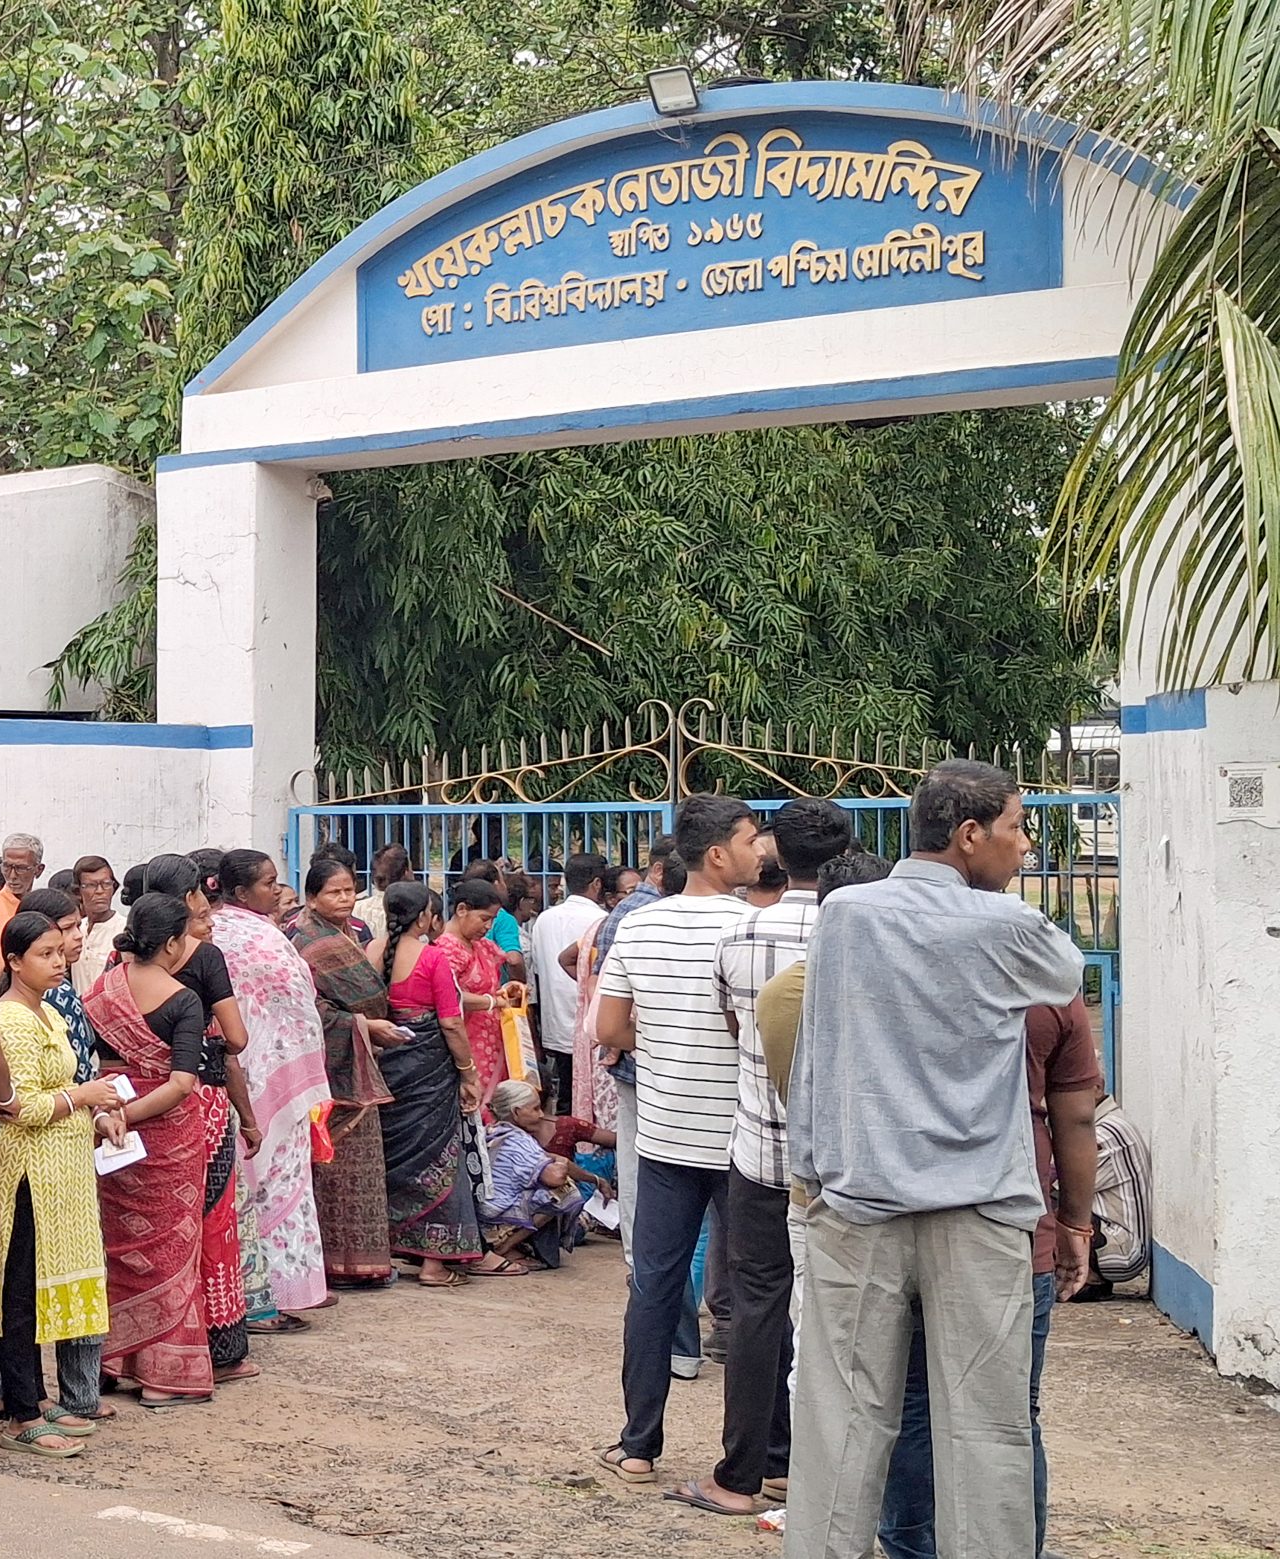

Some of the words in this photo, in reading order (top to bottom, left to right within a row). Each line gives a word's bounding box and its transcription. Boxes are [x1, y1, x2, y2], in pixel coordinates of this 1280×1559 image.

[607, 132, 751, 217] নেতাজী
[754, 128, 983, 215] বিদ্যামন্দির
[608, 217, 670, 257] স্থাপিত
[687, 213, 763, 246] ১৯৬৫
[701, 258, 764, 298] জেলা
[767, 240, 847, 287] পশ্চিম
